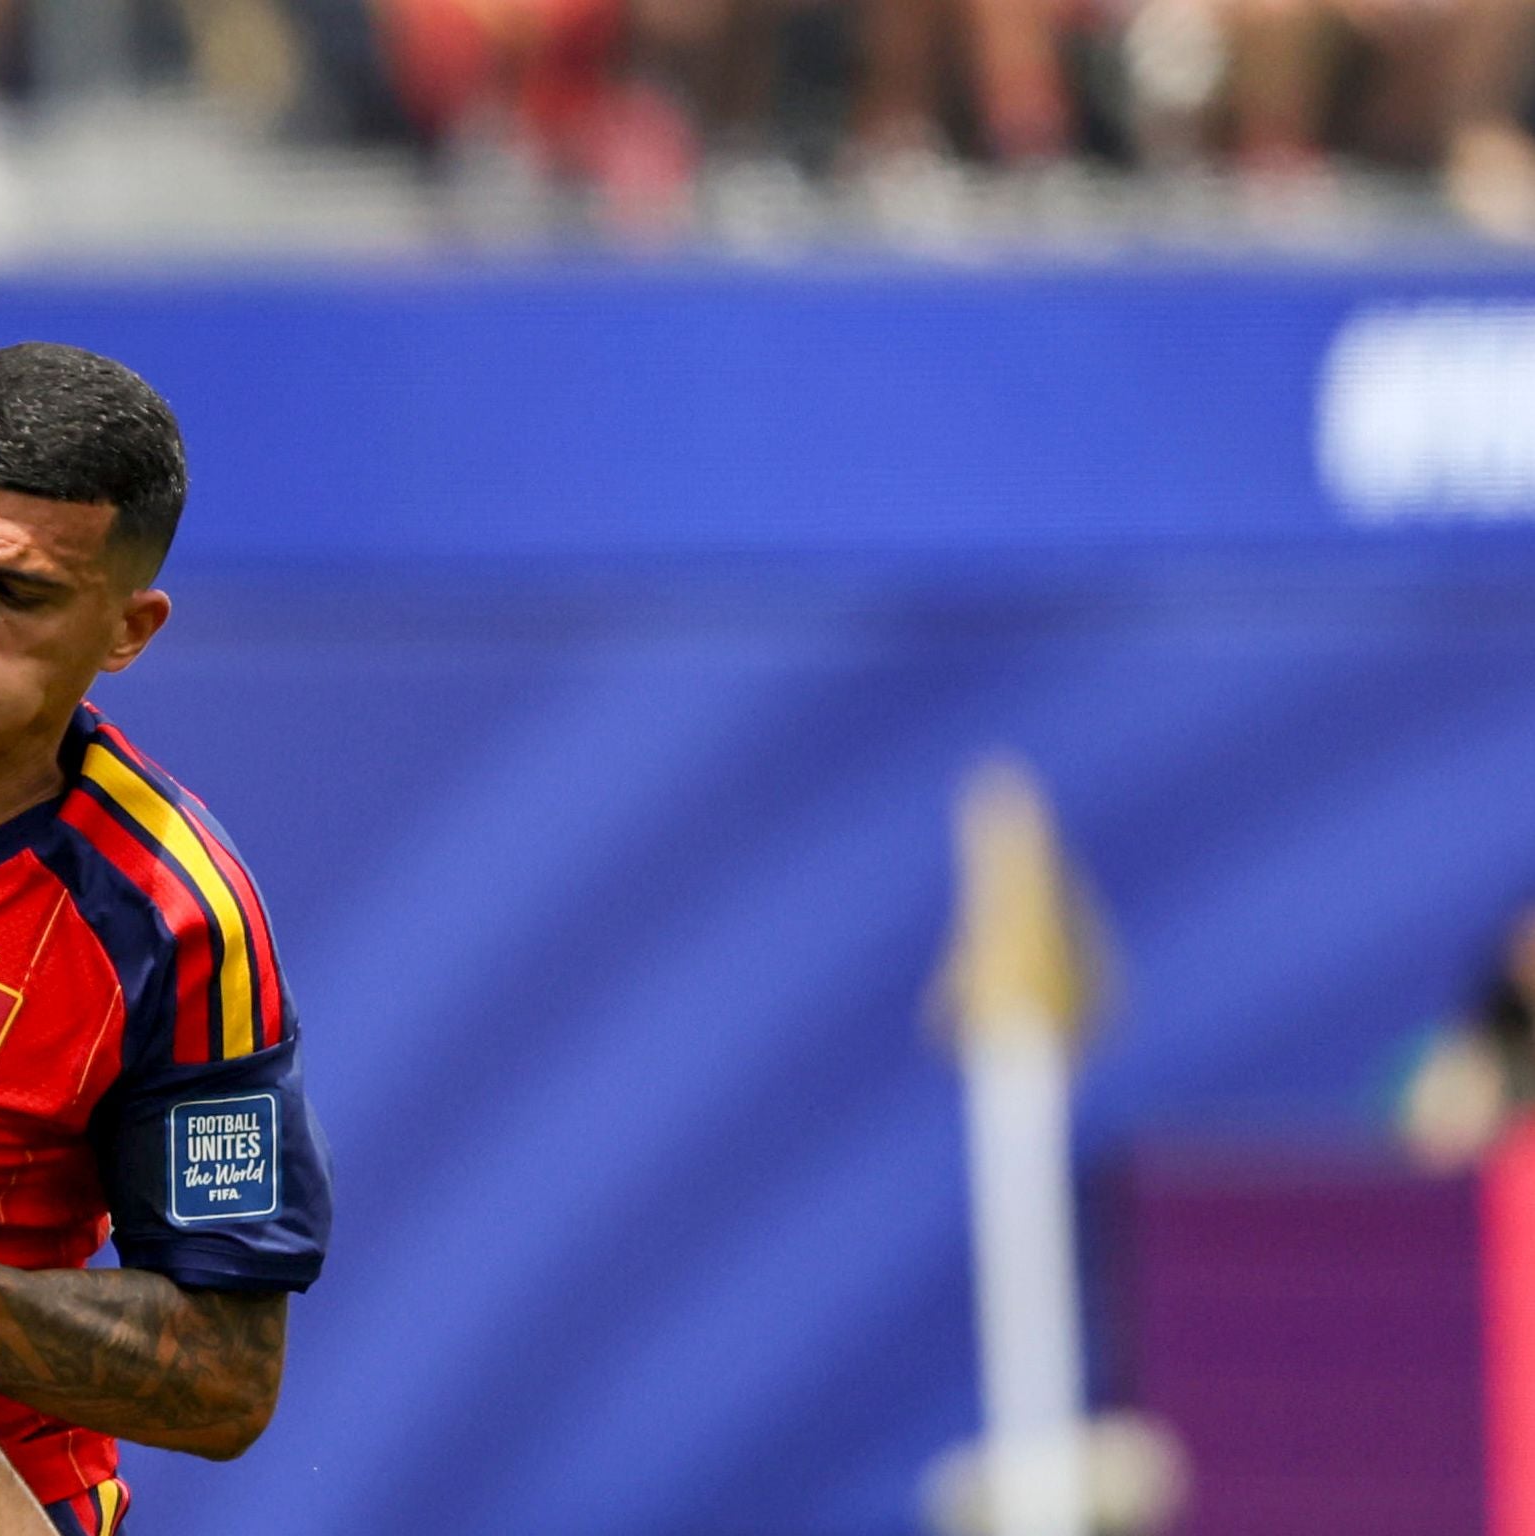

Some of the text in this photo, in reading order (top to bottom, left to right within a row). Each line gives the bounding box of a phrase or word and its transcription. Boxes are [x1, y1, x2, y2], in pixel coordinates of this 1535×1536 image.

[187, 1113, 261, 1135] FOOTBALL
[187, 1132, 261, 1163] UNITES
[182, 1159, 266, 1188] the World
[208, 1187, 240, 1202] FIFA
